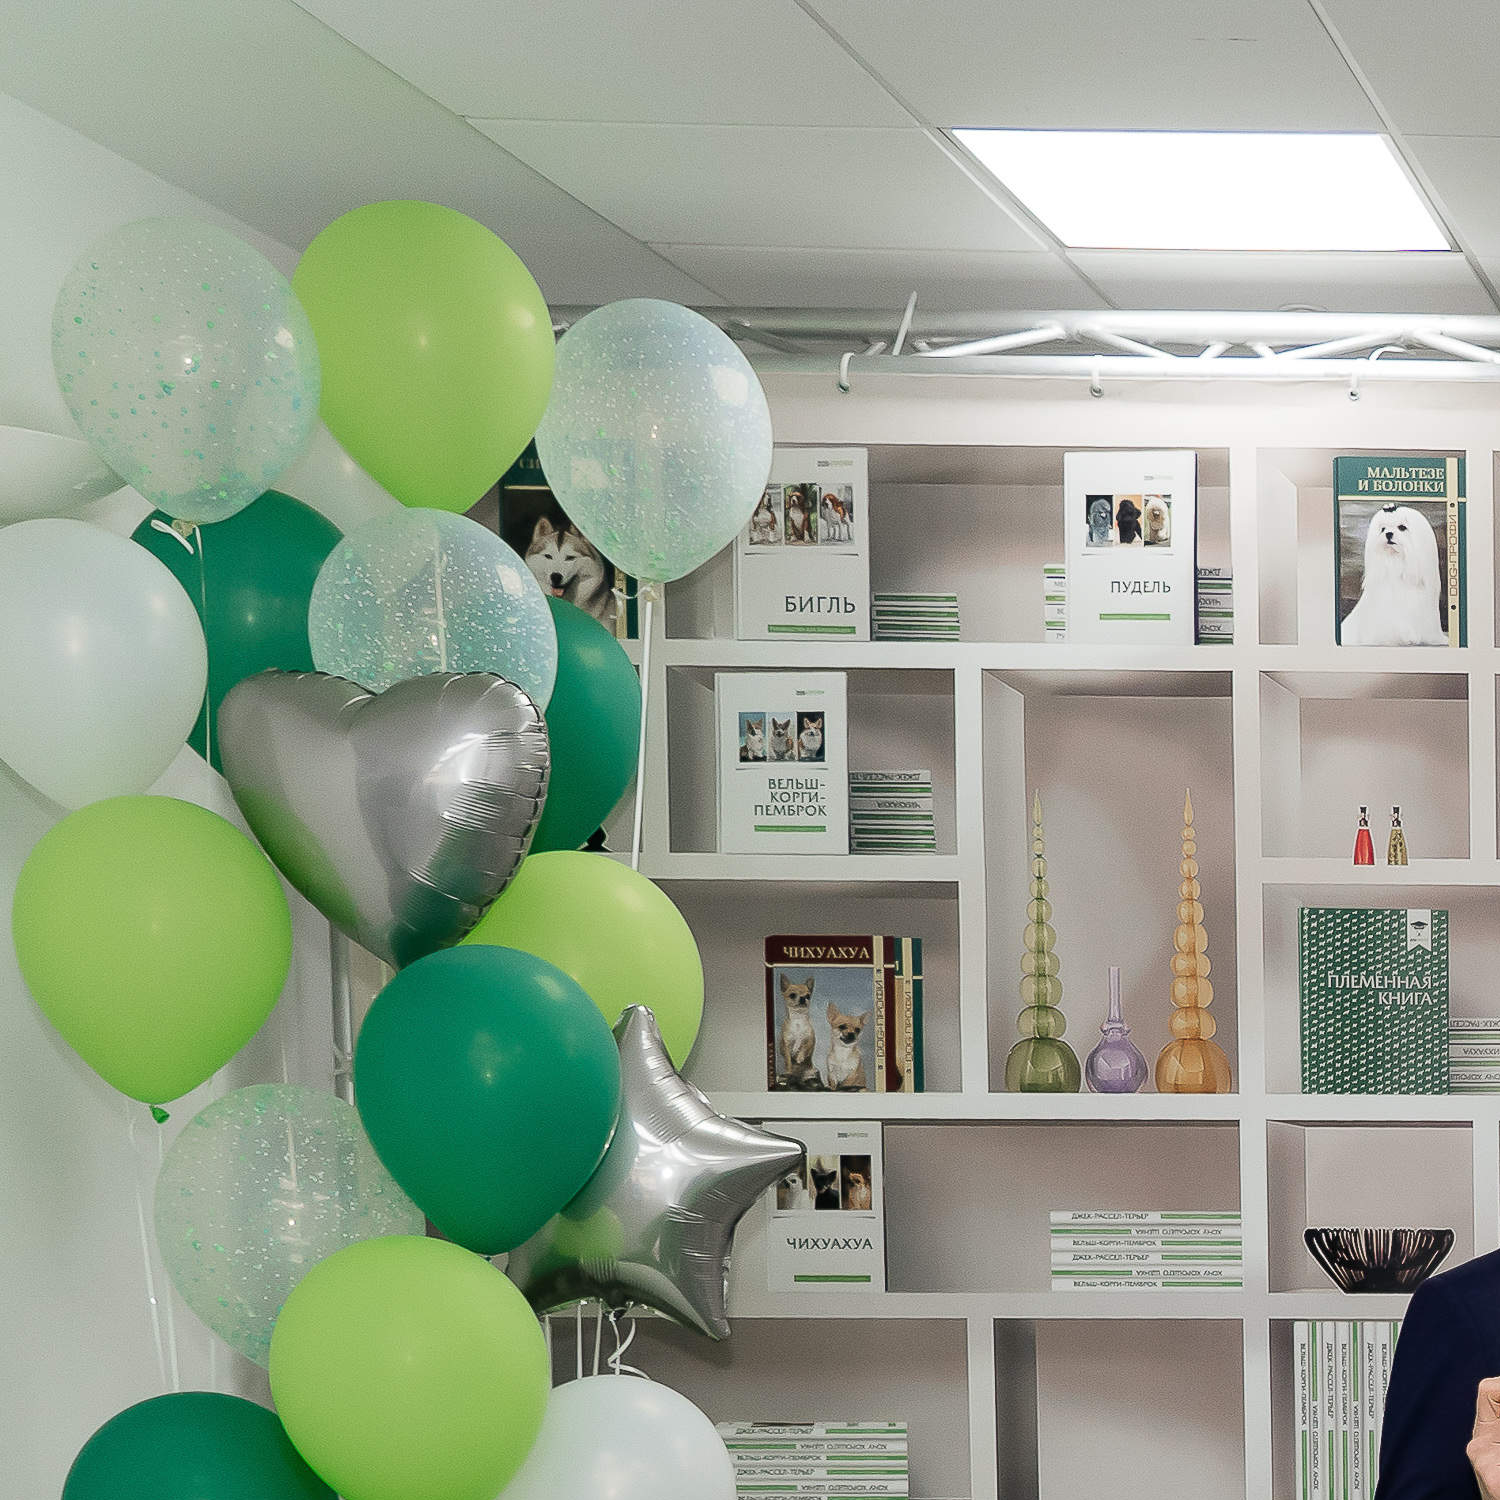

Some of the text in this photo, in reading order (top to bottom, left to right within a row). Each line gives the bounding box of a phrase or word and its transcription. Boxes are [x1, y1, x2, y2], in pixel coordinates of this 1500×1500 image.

[1366, 465, 1445, 482] МАЛЬТЕЗЕ
[1358, 478, 1445, 495] И БОЛОНКИ
[1110, 580, 1172, 596] ПУДЕЛЬ
[784, 595, 856, 615] БИГЛЬ
[767, 777, 826, 790] ВЕЛЬШ-
[770, 790, 826, 803] КОРГИ-
[753, 803, 828, 817] ПЕМБРОК
[782, 945, 871, 960] ЧИХУАХУА
[1327, 970, 1433, 992] ПЛЕМЕННАЯ
[1377, 989, 1433, 1007] КНИГА
[786, 1235, 874, 1252] ЧИХУАХУА
